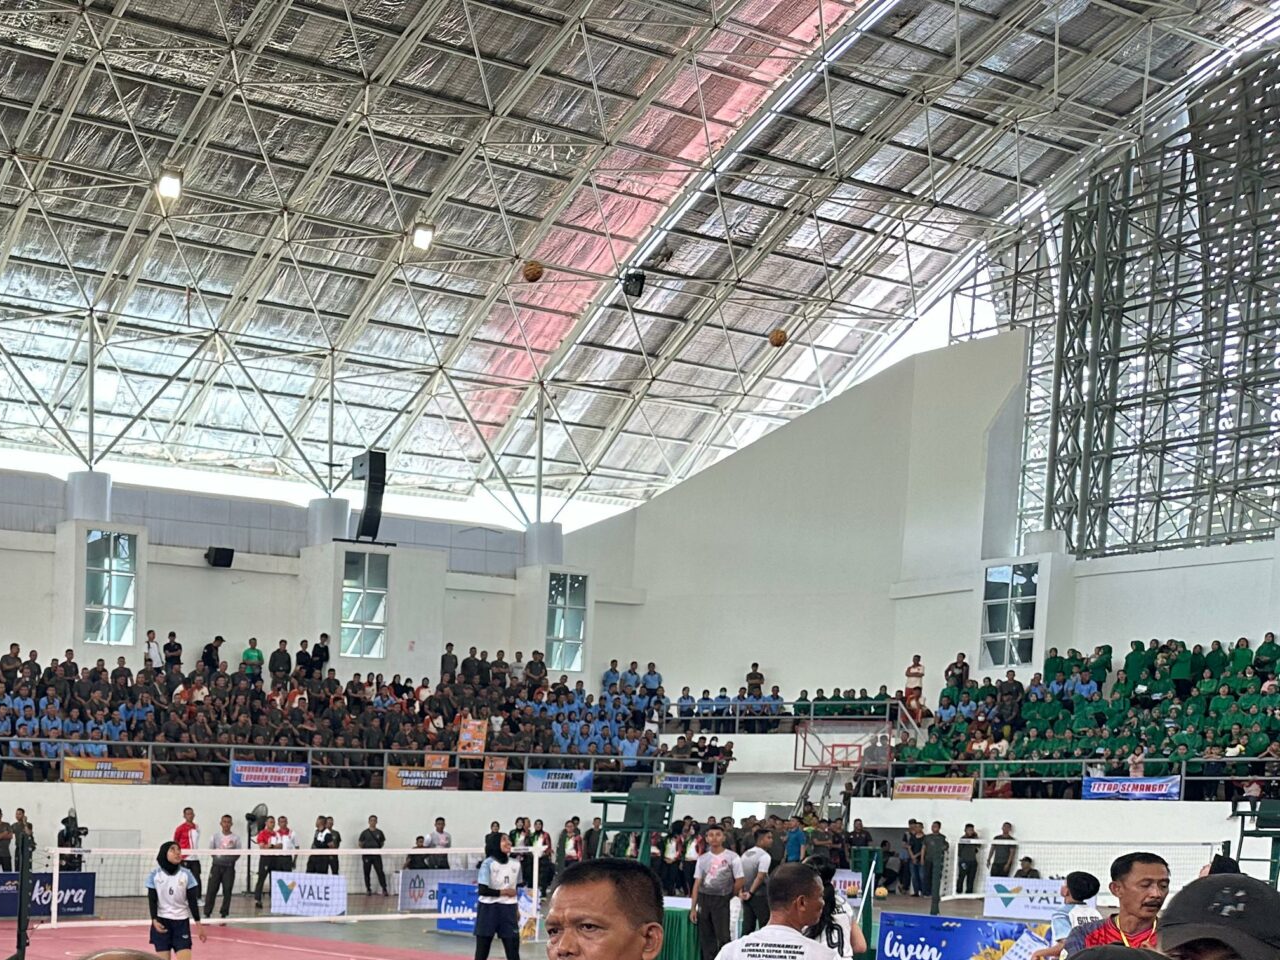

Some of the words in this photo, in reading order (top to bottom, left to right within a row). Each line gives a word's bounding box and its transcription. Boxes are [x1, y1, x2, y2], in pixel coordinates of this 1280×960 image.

[1092, 782, 1119, 792] TETAP
[1120, 782, 1170, 793] SEMANGAT
[298, 884, 330, 901] VALE
